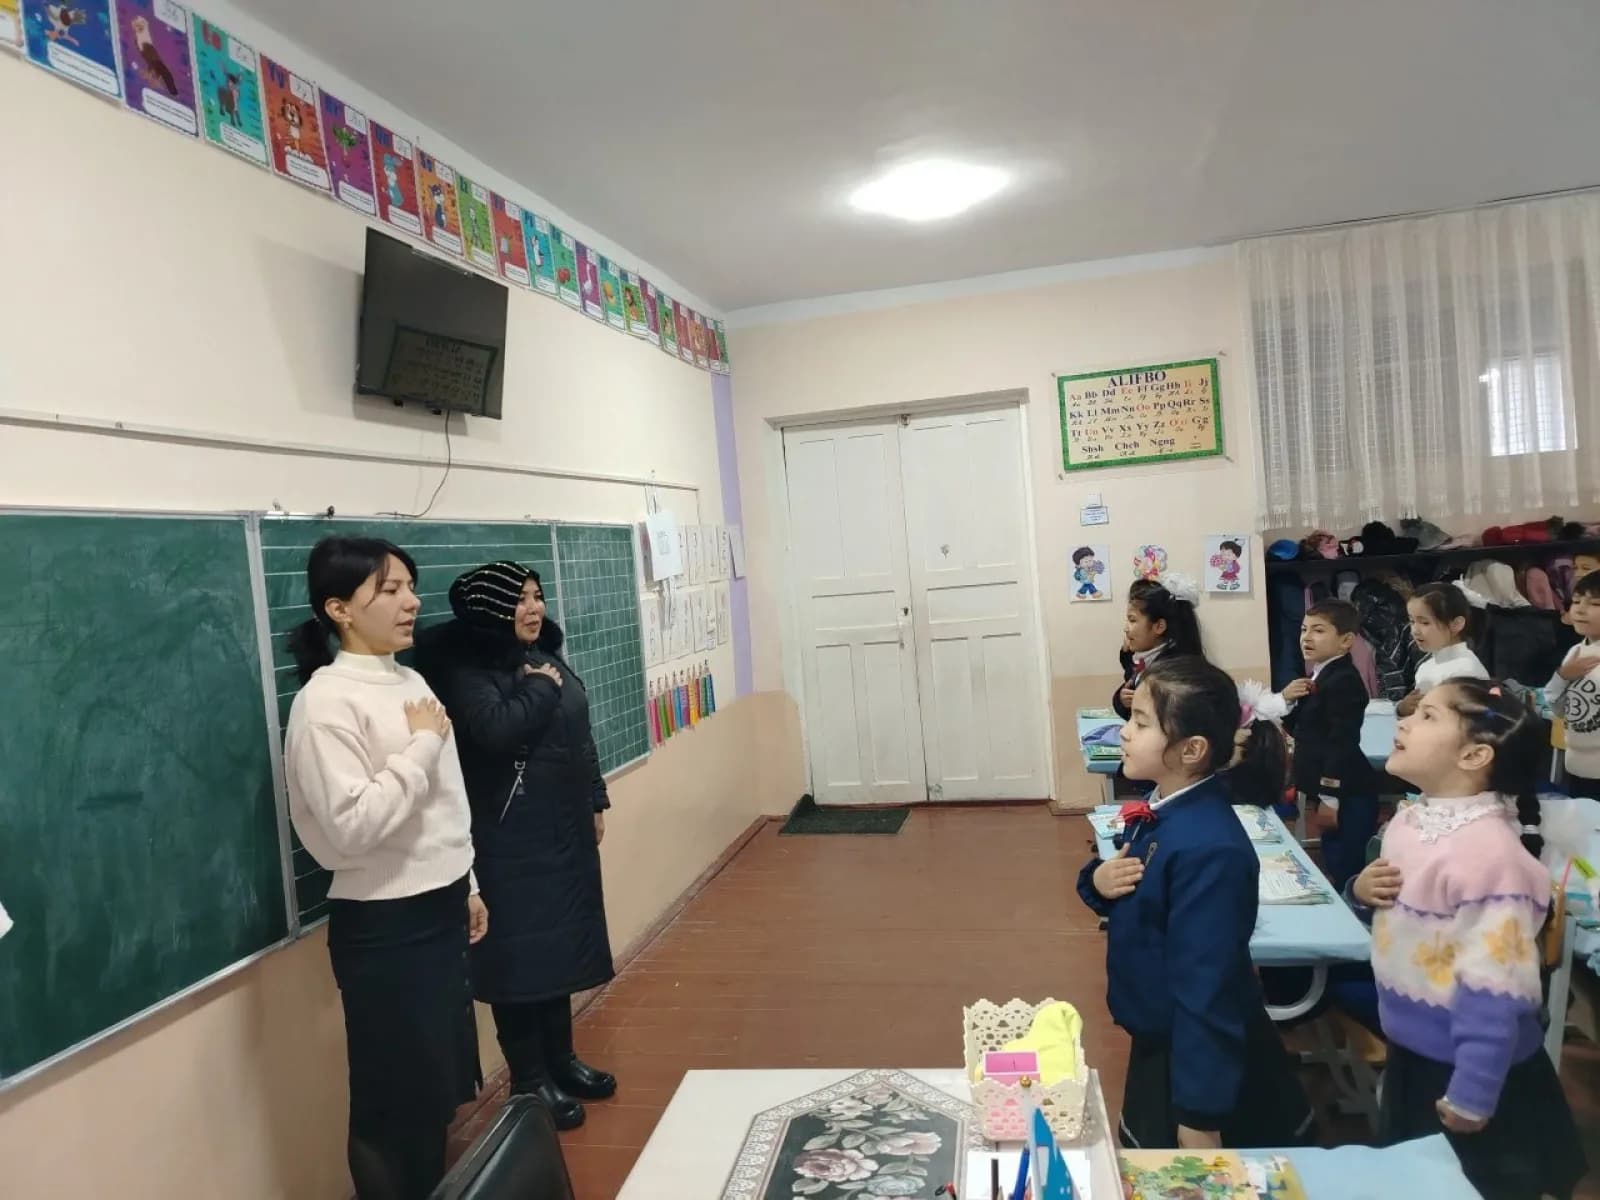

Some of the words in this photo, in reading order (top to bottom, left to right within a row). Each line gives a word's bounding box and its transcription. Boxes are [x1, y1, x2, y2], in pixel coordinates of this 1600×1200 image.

[1107, 370, 1167, 388] ALIFBO
[1102, 388, 1116, 397] Dd
[1101, 406, 1120, 415] Mm
[1167, 399, 1182, 409] Qq
[1081, 444, 1104, 454] Shsh
[1114, 440, 1140, 451] Chch
